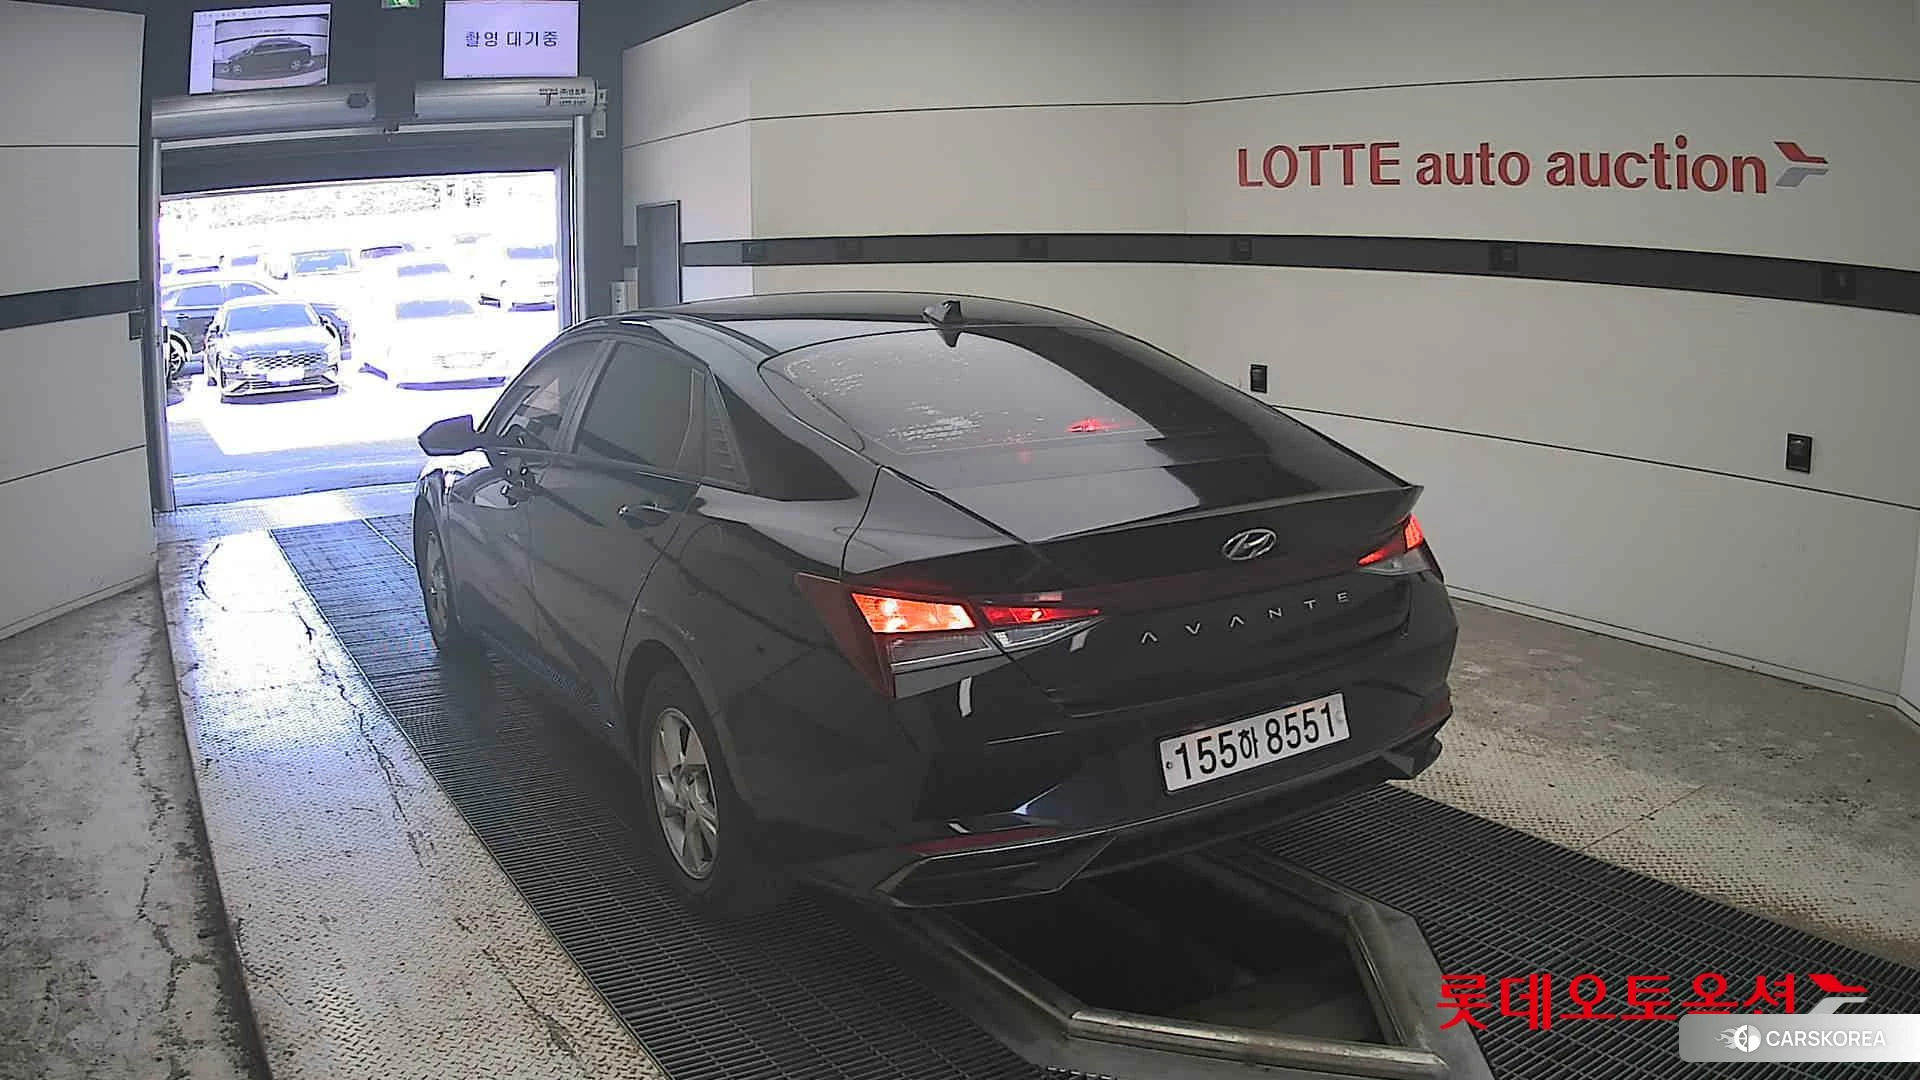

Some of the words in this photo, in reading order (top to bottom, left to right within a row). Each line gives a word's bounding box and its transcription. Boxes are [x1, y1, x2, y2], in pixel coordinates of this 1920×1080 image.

[1236, 142, 1399, 188] LOTTE
[1416, 142, 1531, 187] auto
[1546, 136, 1767, 193] auction
[1141, 592, 1349, 643] AVANTE
[1174, 726, 1259, 780] 155하
[1264, 701, 1336, 755] 8551
